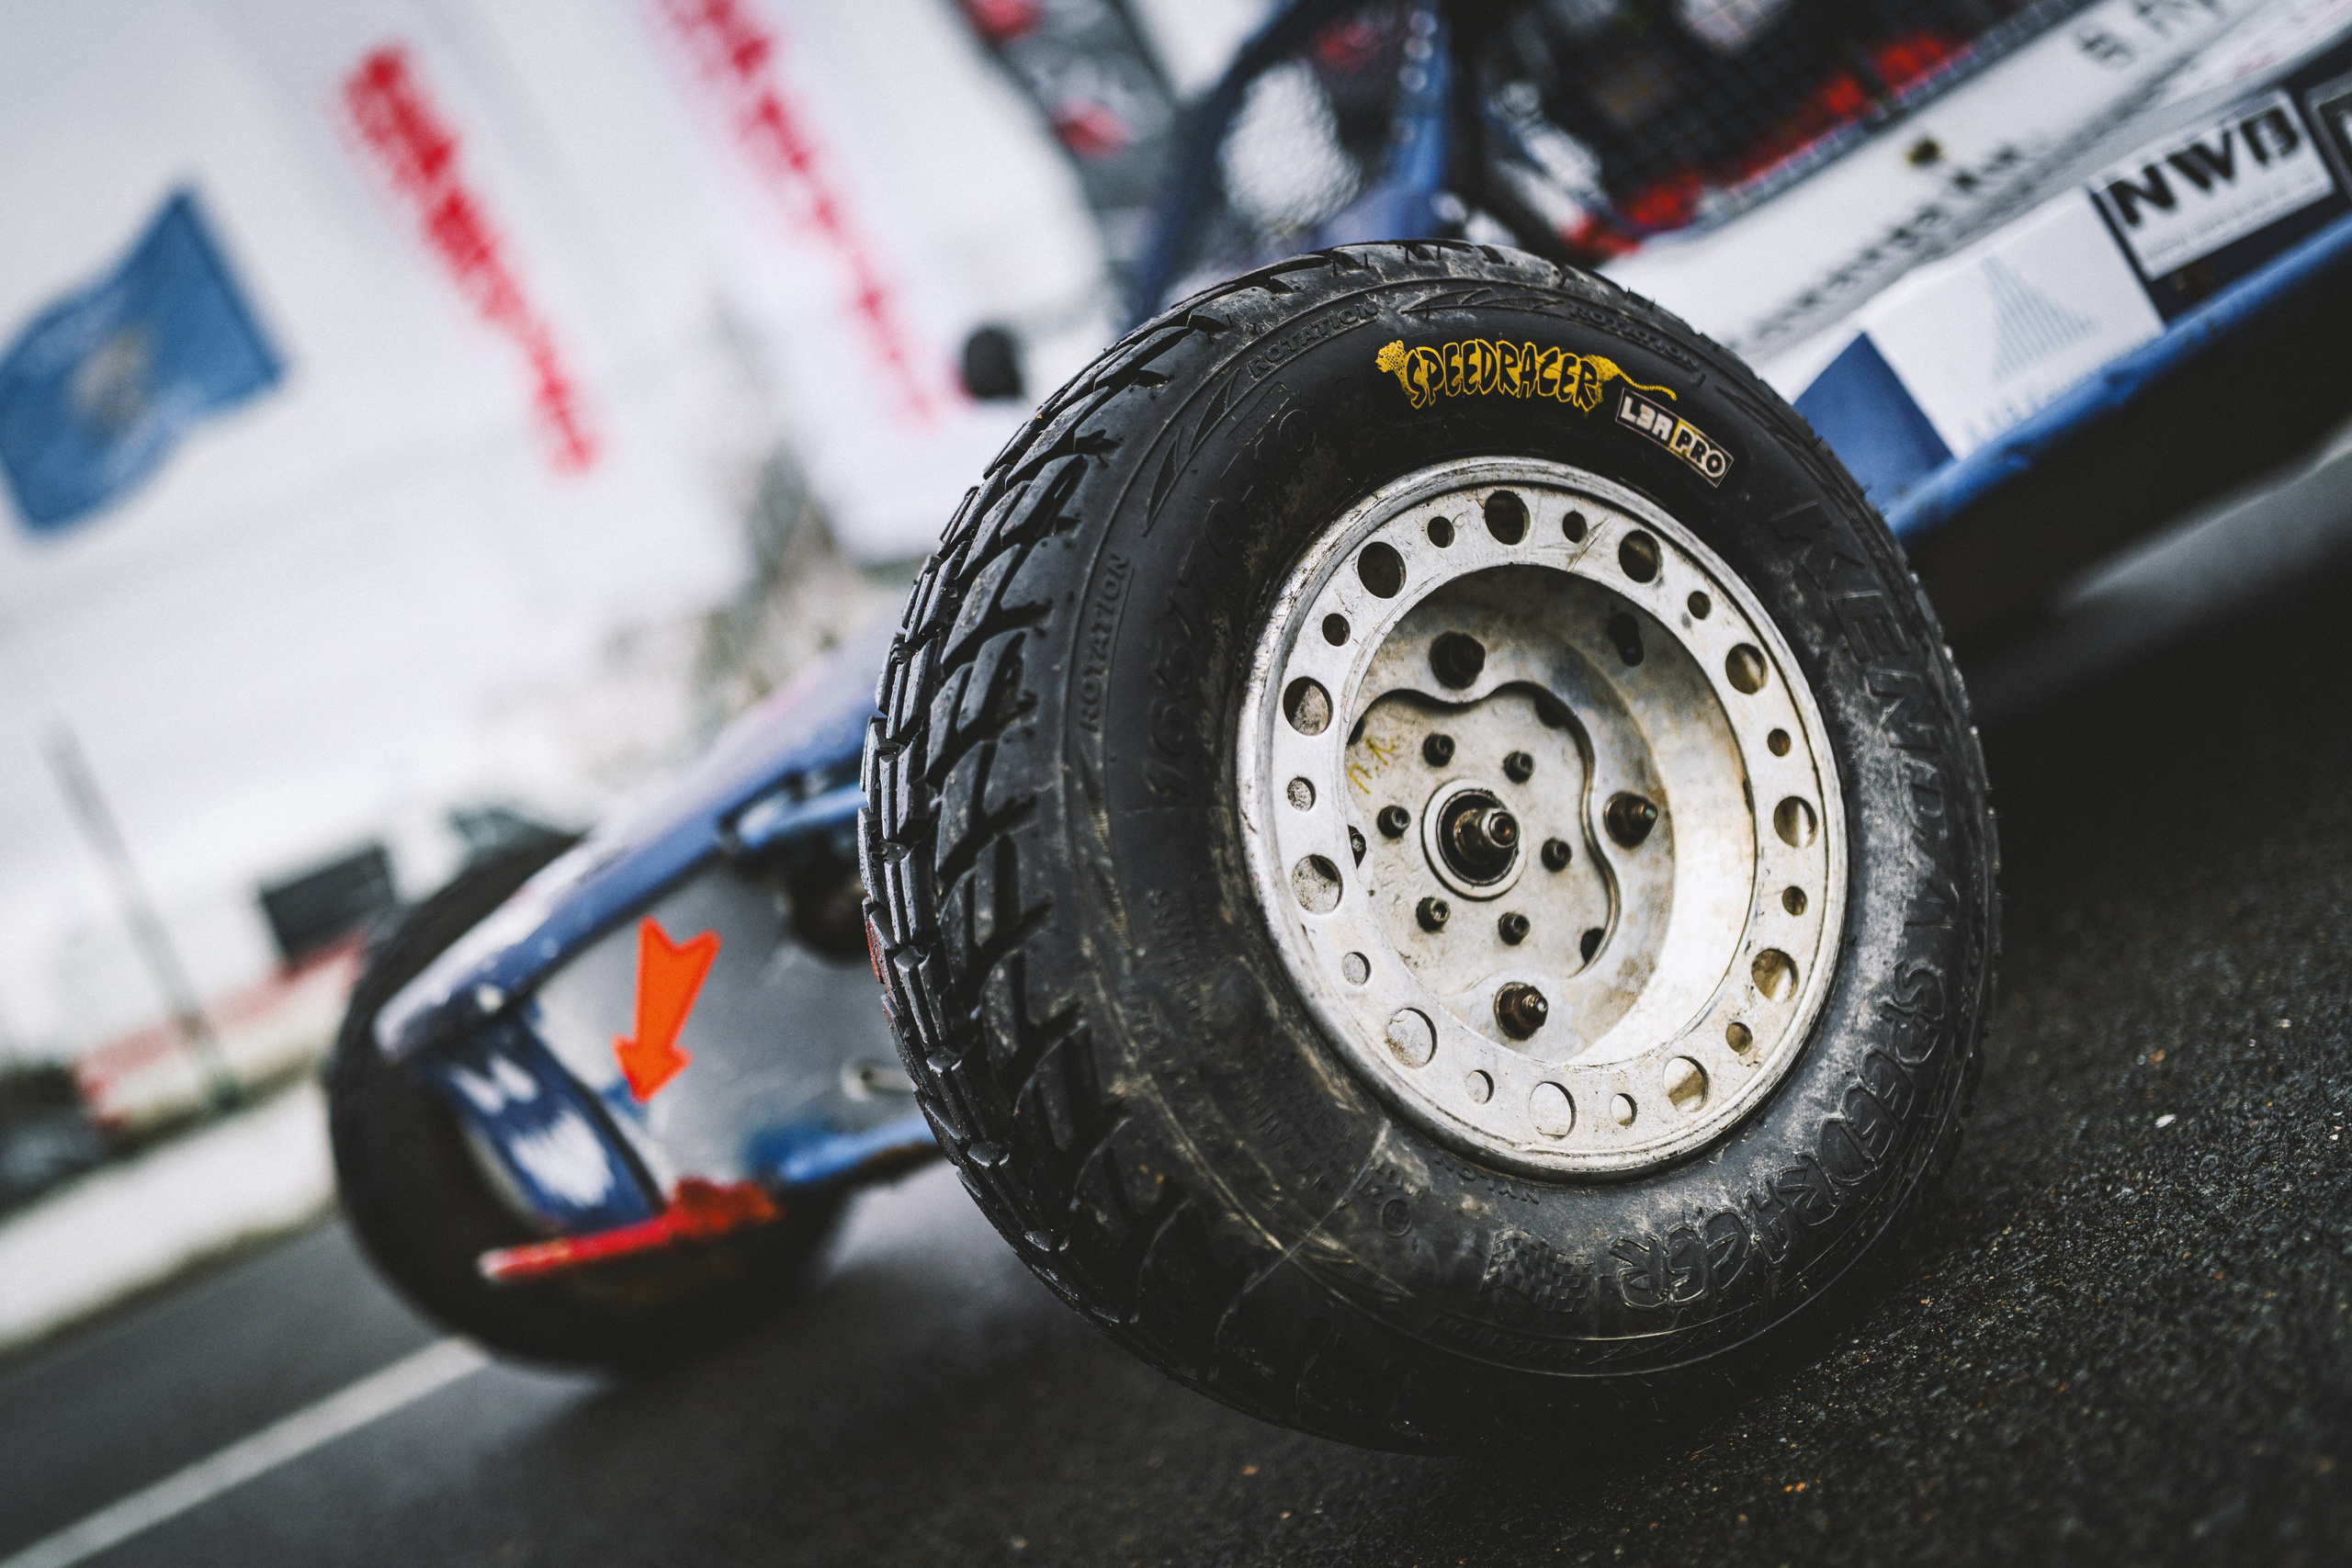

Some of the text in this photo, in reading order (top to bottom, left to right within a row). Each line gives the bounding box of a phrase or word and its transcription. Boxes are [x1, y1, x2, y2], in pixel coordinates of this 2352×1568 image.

[1248, 298, 1378, 378] ROTATION
[1406, 338, 1600, 412] SPEEDRACER
[1566, 304, 1702, 371] ROTATION
[1672, 423, 1726, 479] PRO
[1079, 553, 1130, 732] ROTATION
[1770, 499, 1961, 928] KENDA
[1608, 961, 1947, 1311] SPEEDRACER
[1433, 1155, 1541, 1205] NYLON
